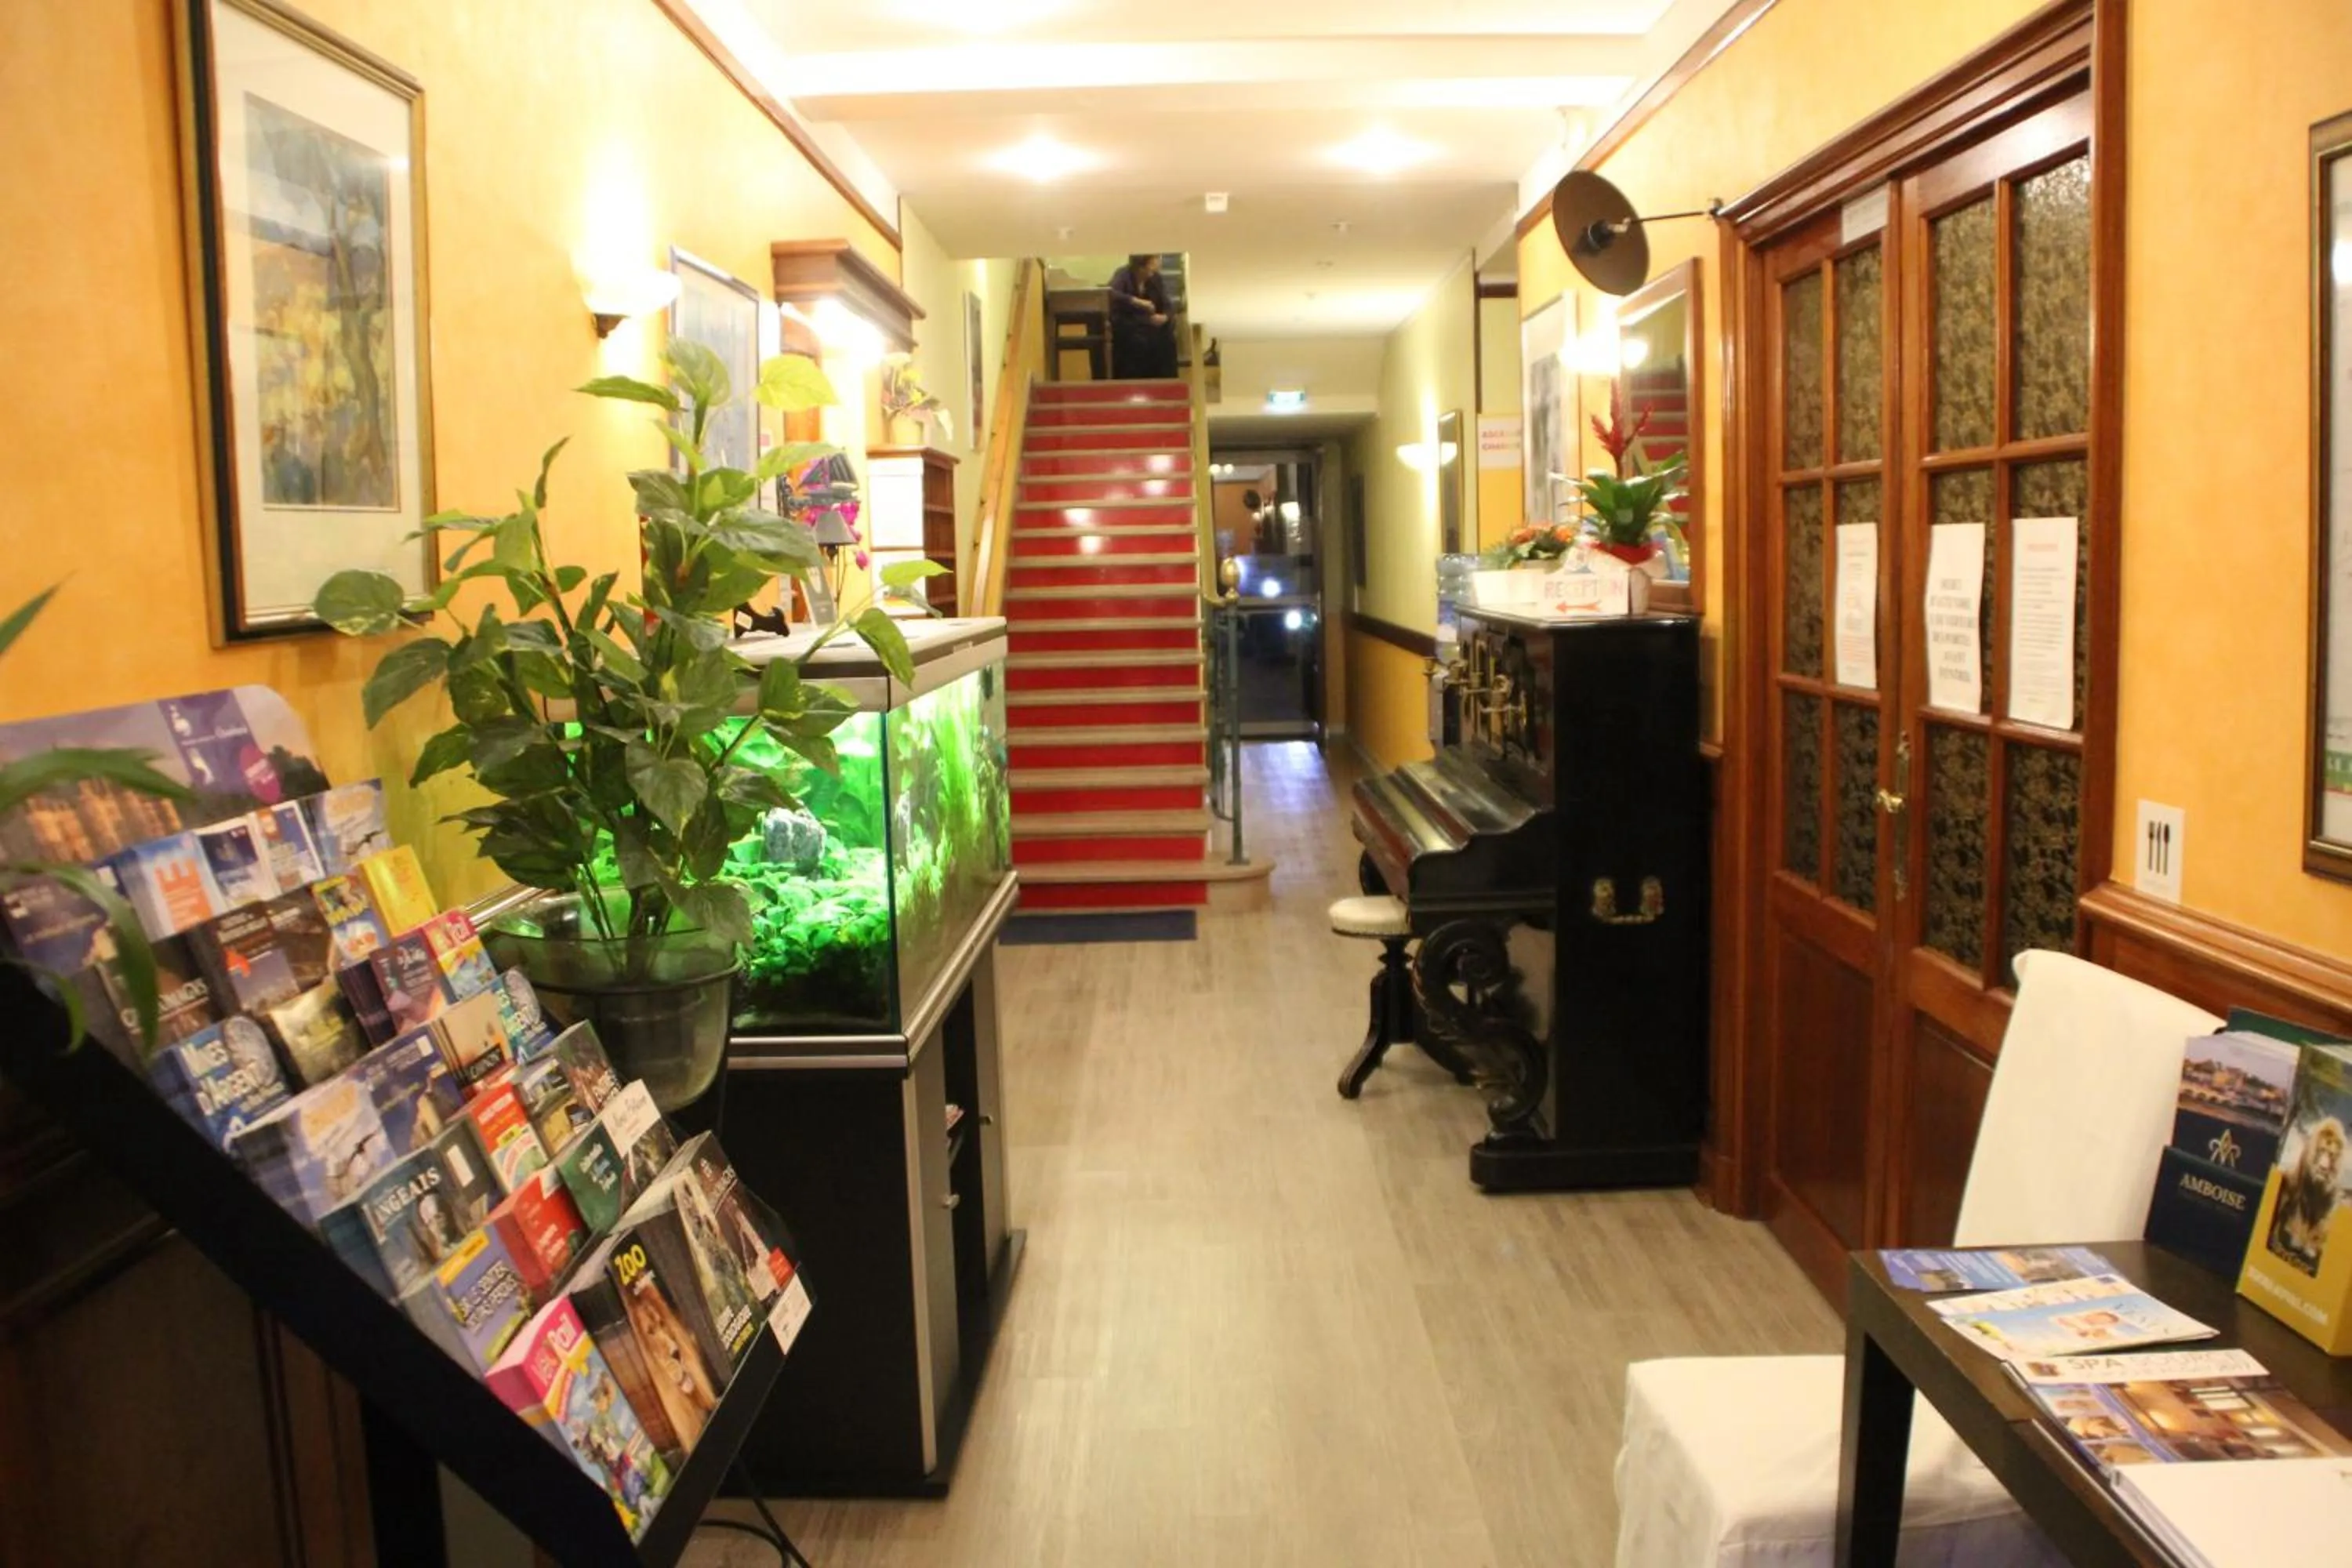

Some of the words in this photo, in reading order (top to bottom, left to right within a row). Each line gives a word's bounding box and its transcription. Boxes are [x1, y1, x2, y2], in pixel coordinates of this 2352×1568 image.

[1544, 579, 1624, 599] REEPTN
[2180, 1173, 2247, 1210] AMBOISE
[2067, 1357, 2122, 1371] SPA
